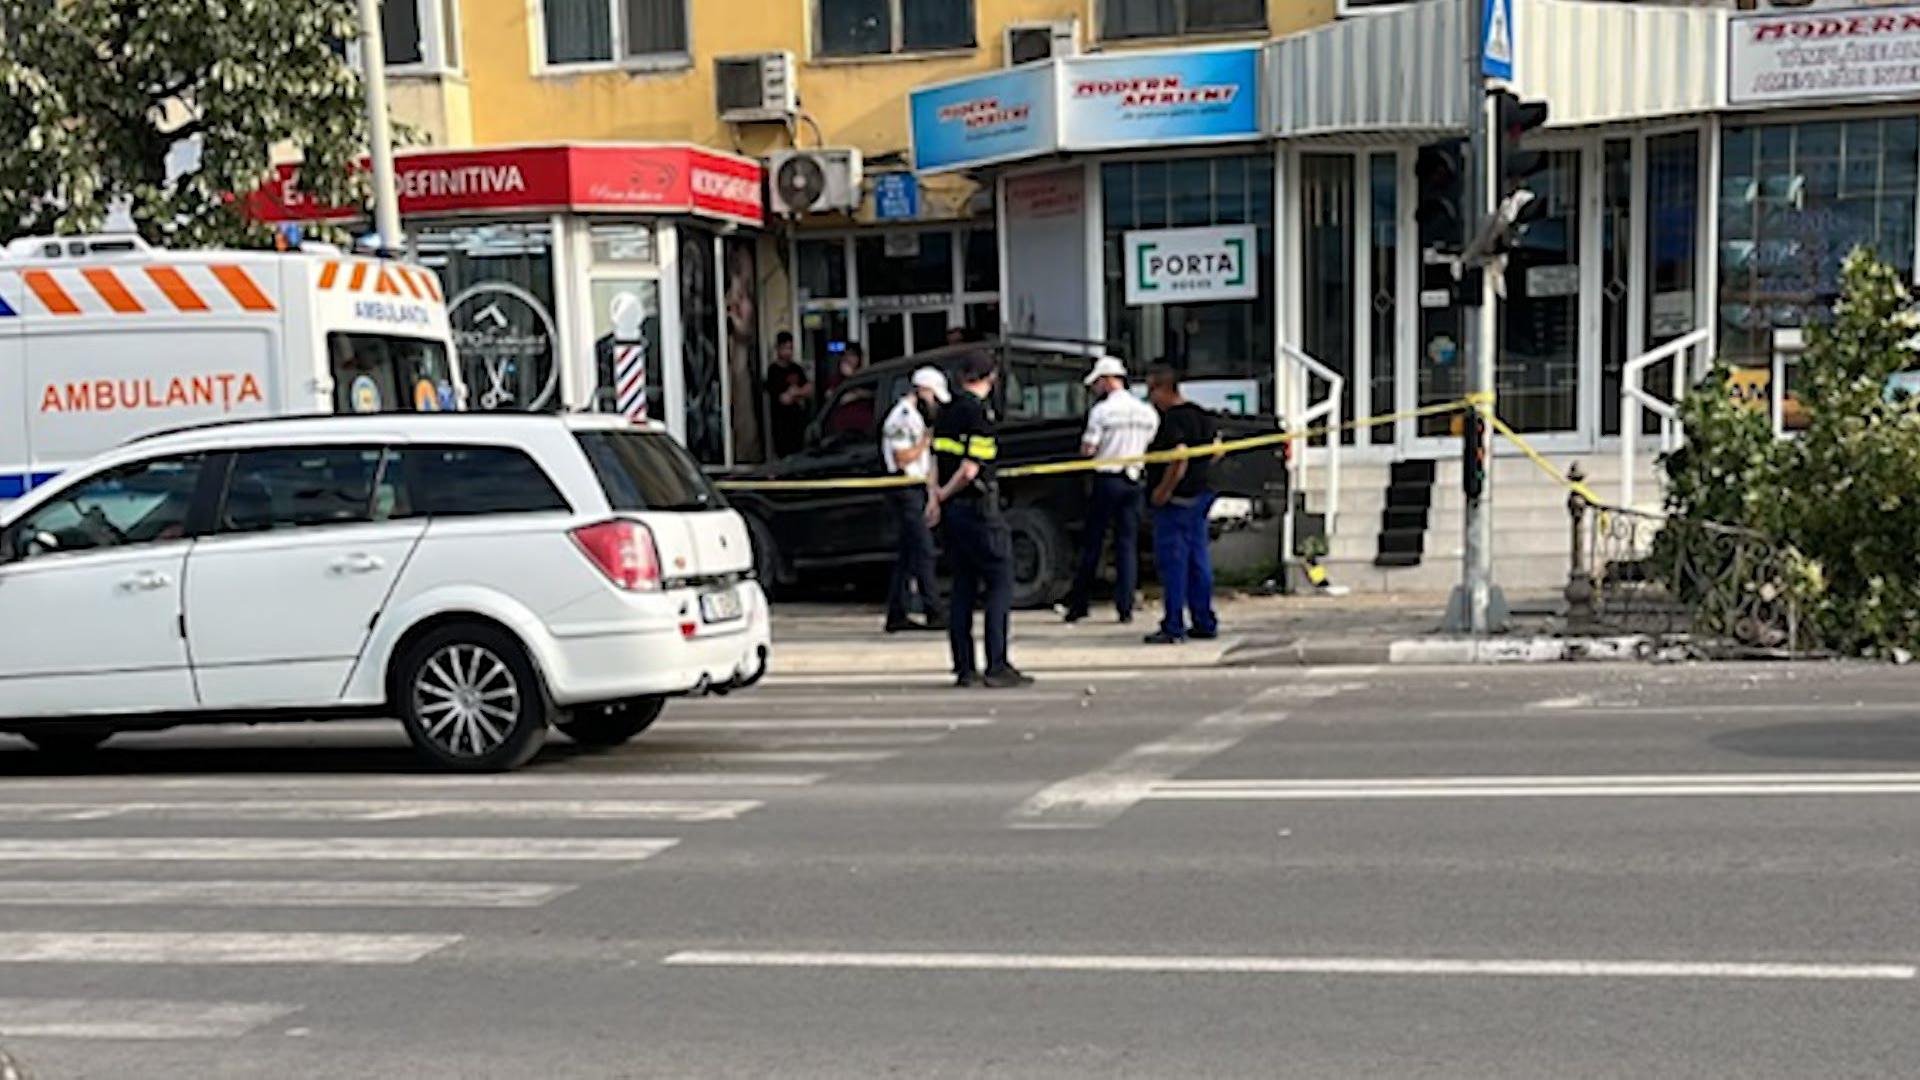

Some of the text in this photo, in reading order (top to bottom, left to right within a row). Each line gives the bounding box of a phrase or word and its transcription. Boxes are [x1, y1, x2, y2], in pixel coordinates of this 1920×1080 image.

[1075, 77, 1180, 96] MODERN
[1149, 253, 1234, 276] PORTA
[40, 372, 263, 414] AMBULANȚA
